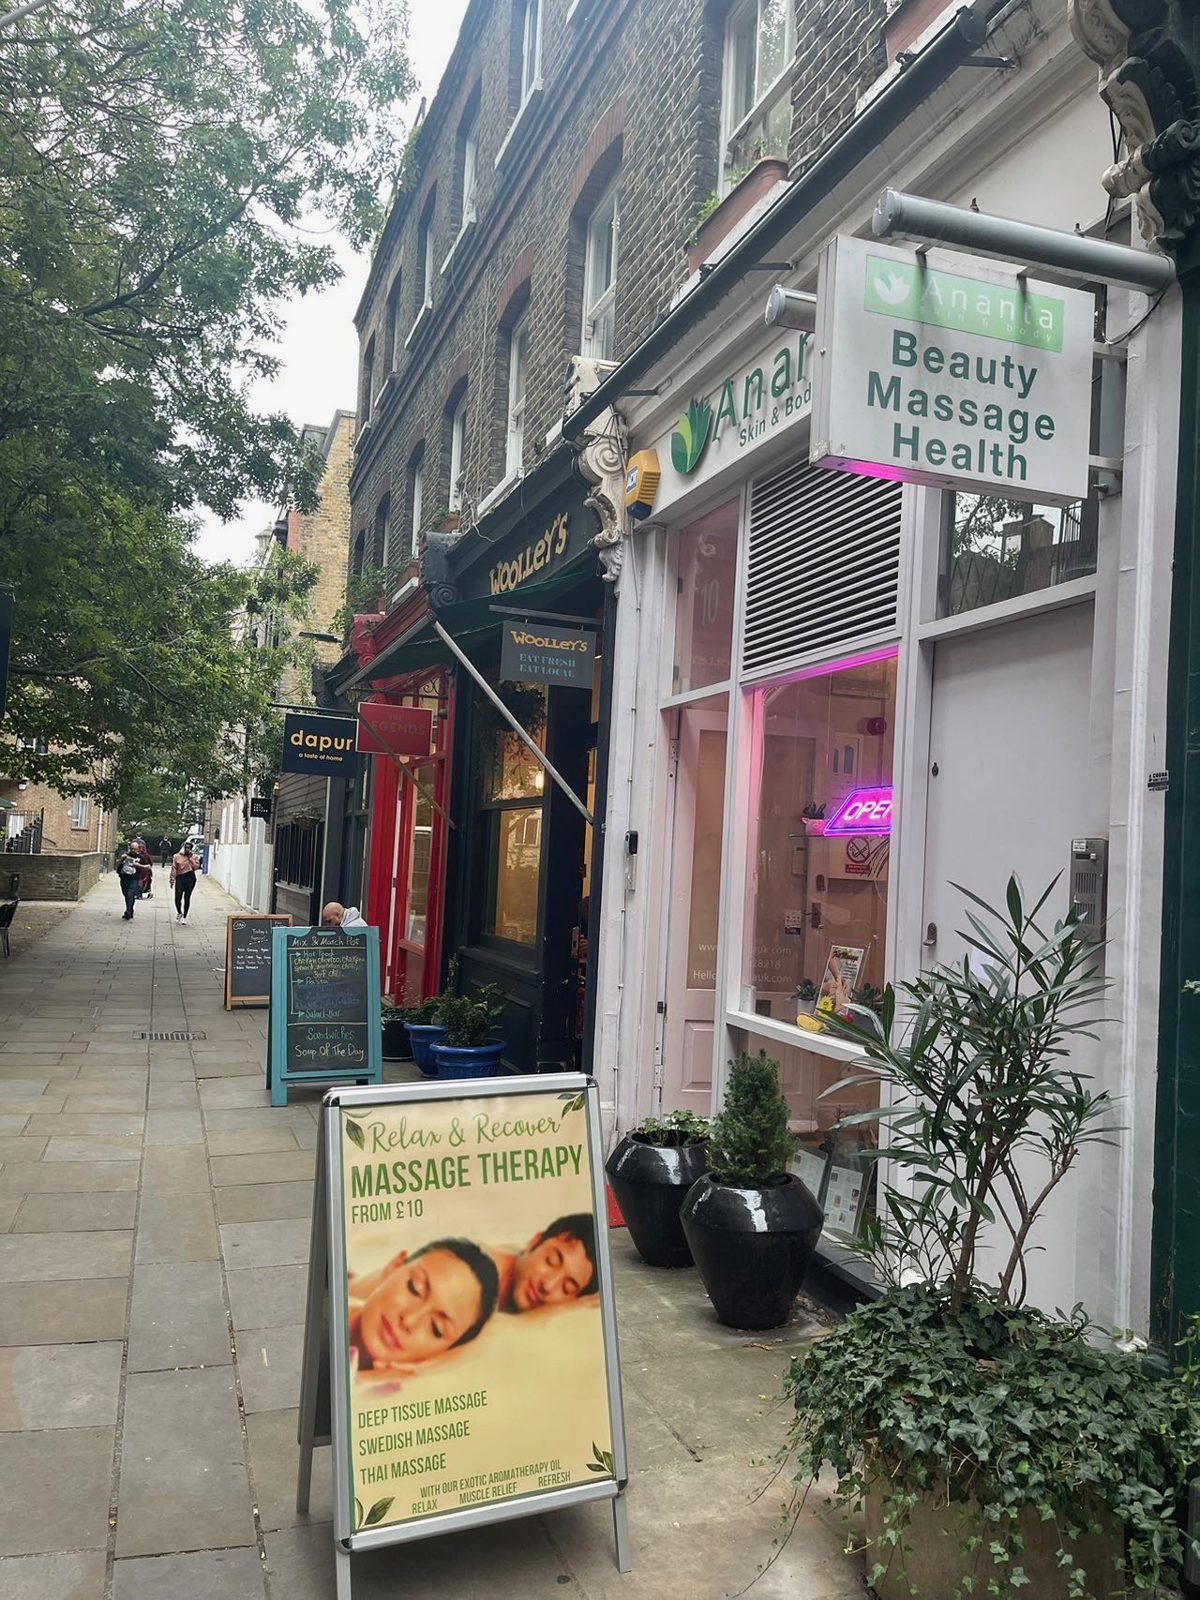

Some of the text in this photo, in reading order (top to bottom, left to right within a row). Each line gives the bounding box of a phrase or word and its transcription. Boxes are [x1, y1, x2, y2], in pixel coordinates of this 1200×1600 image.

[921, 276, 1054, 330] Ananta
[1006, 324, 1051, 342] body
[892, 329, 1038, 399] Beauty
[867, 371, 1056, 444] Massage
[739, 419, 766, 448] Skin
[771, 407, 779, 426] &
[892, 422, 1028, 481] Health
[701, 578, 720, 625] 10
[519, 653, 576, 668] EAT FRESH
[519, 664, 576, 678] EAT LOCAL
[290, 730, 353, 752] dapur
[369, 720, 425, 736] EGENDS
[292, 936, 360, 947] Mix & Match Pot
[305, 976, 328, 985] Pasta
[306, 1027, 354, 1041] Sandwiches
[295, 1044, 365, 1062] Soup Of The Day
[368, 1112, 561, 1154] Relax & Recover
[351, 1144, 583, 1199] MASSAGE THERAPY
[351, 1199, 424, 1224] FROM £10
[358, 1390, 488, 1429] DEEP TISSUE MASSAGE
[359, 1420, 471, 1457] SWEDISH MASSAGE
[360, 1452, 447, 1485] THAI MASSAGE
[420, 1459, 562, 1498] WITH OUR EXOTIC AROMATHERAPY OIL
[412, 1471, 571, 1514] RELAX MUSCLE RELIEF REFRESH
